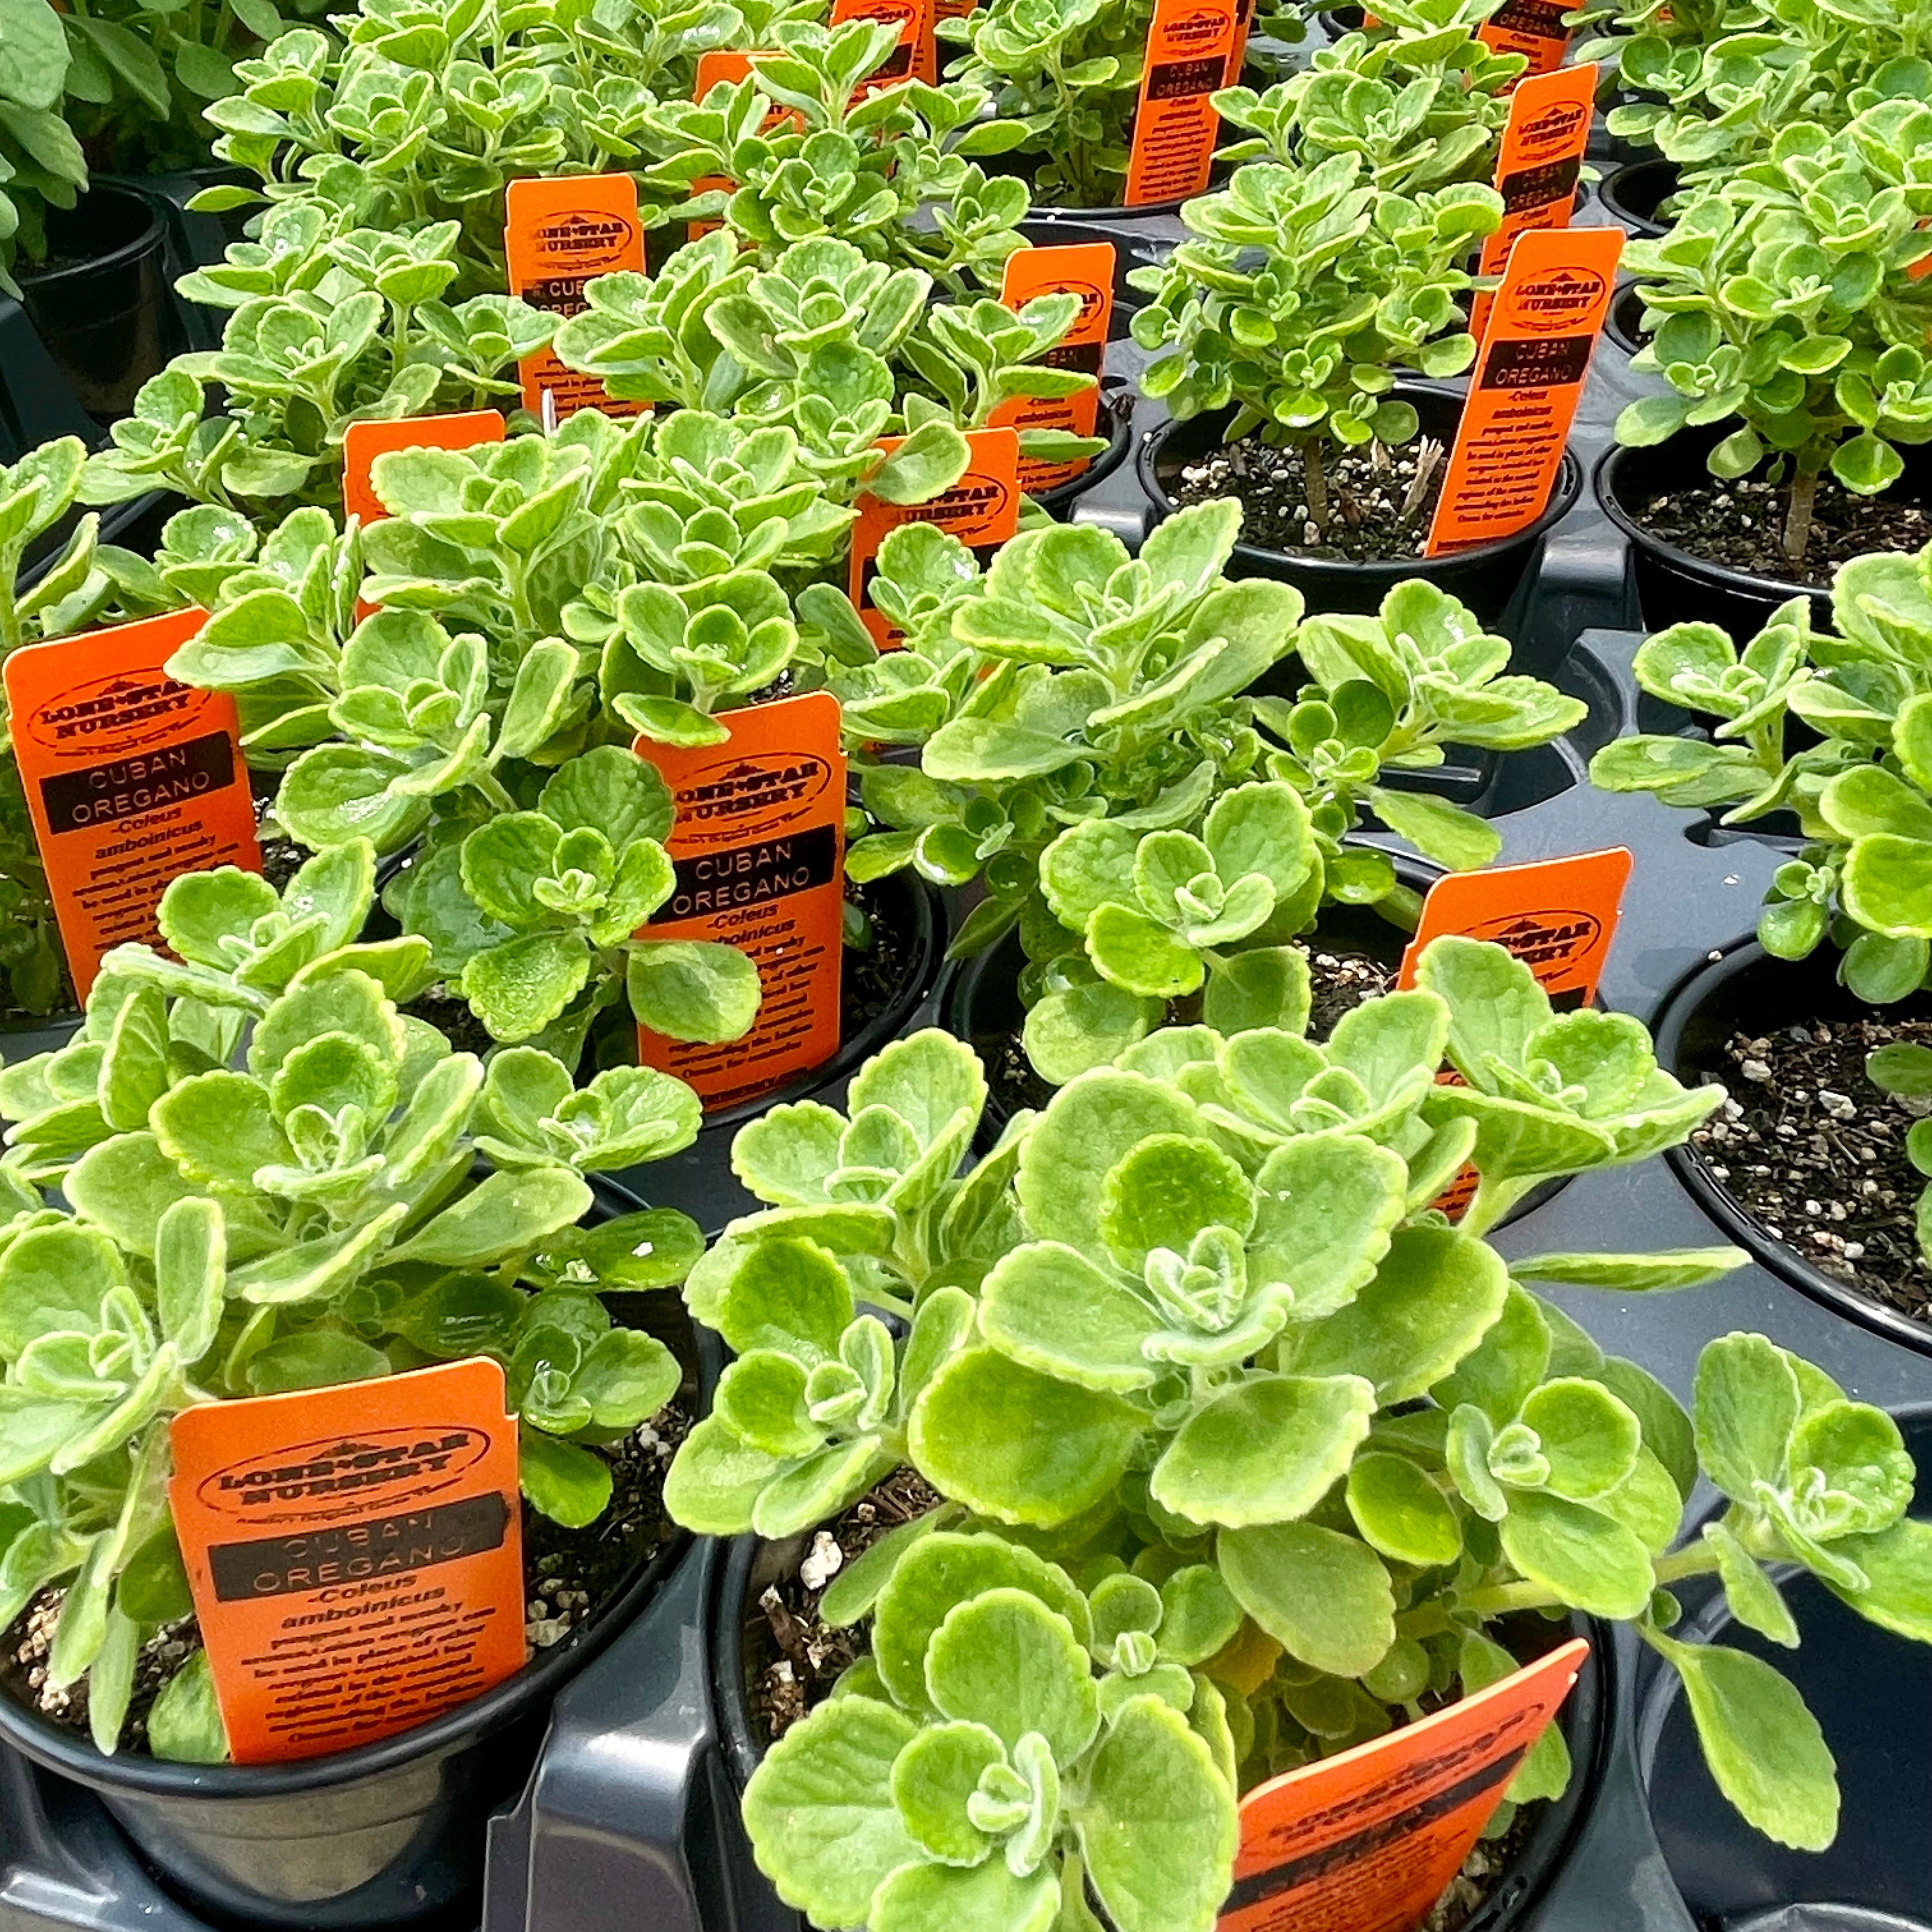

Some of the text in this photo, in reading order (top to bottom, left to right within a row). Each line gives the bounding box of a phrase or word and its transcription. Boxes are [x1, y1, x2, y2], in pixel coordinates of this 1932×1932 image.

[55, 693, 190, 740] NURSERY
[88, 748, 187, 790] CUBAN
[72, 770, 210, 823] OREGANO
[675, 781, 735, 804] ONE
[94, 820, 204, 859] amboinicus
[694, 841, 792, 881] CUBAN
[672, 866, 809, 915] OREGANO
[218, 1434, 470, 1491] LONE STAR
[240, 1453, 452, 1506] NURSERY
[282, 1513, 433, 1559] CUBAN
[253, 1537, 466, 1593] OREGANO
[280, 1586, 446, 1630] amboinicus
